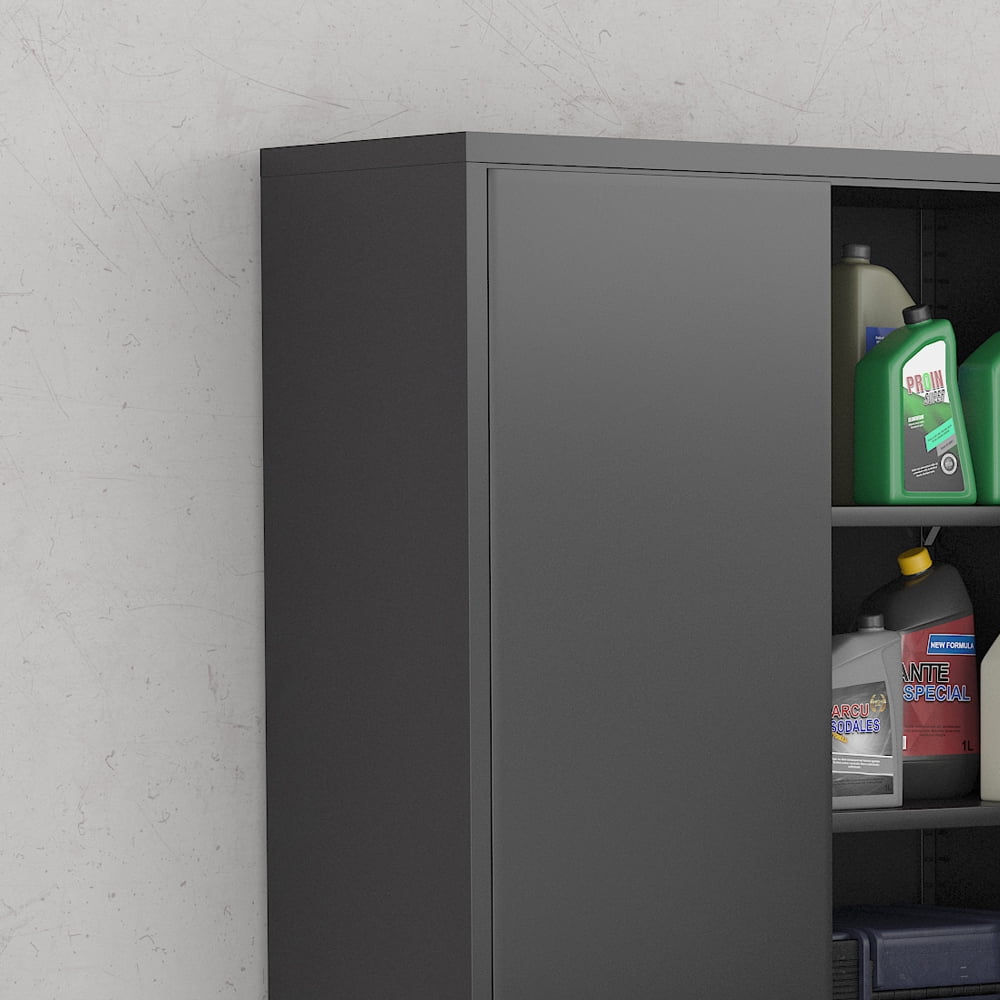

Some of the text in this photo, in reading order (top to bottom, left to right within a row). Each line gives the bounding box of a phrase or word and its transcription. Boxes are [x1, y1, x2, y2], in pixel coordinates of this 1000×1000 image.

[906, 370, 944, 394] PROIN
[924, 389, 945, 406] SUPER
[930, 641, 974, 650] NEW FORMULA
[903, 685, 971, 701] SPECIAL
[832, 703, 869, 718] ARCU
[832, 719, 880, 734] SODALES
[962, 740, 974, 752] 1L
